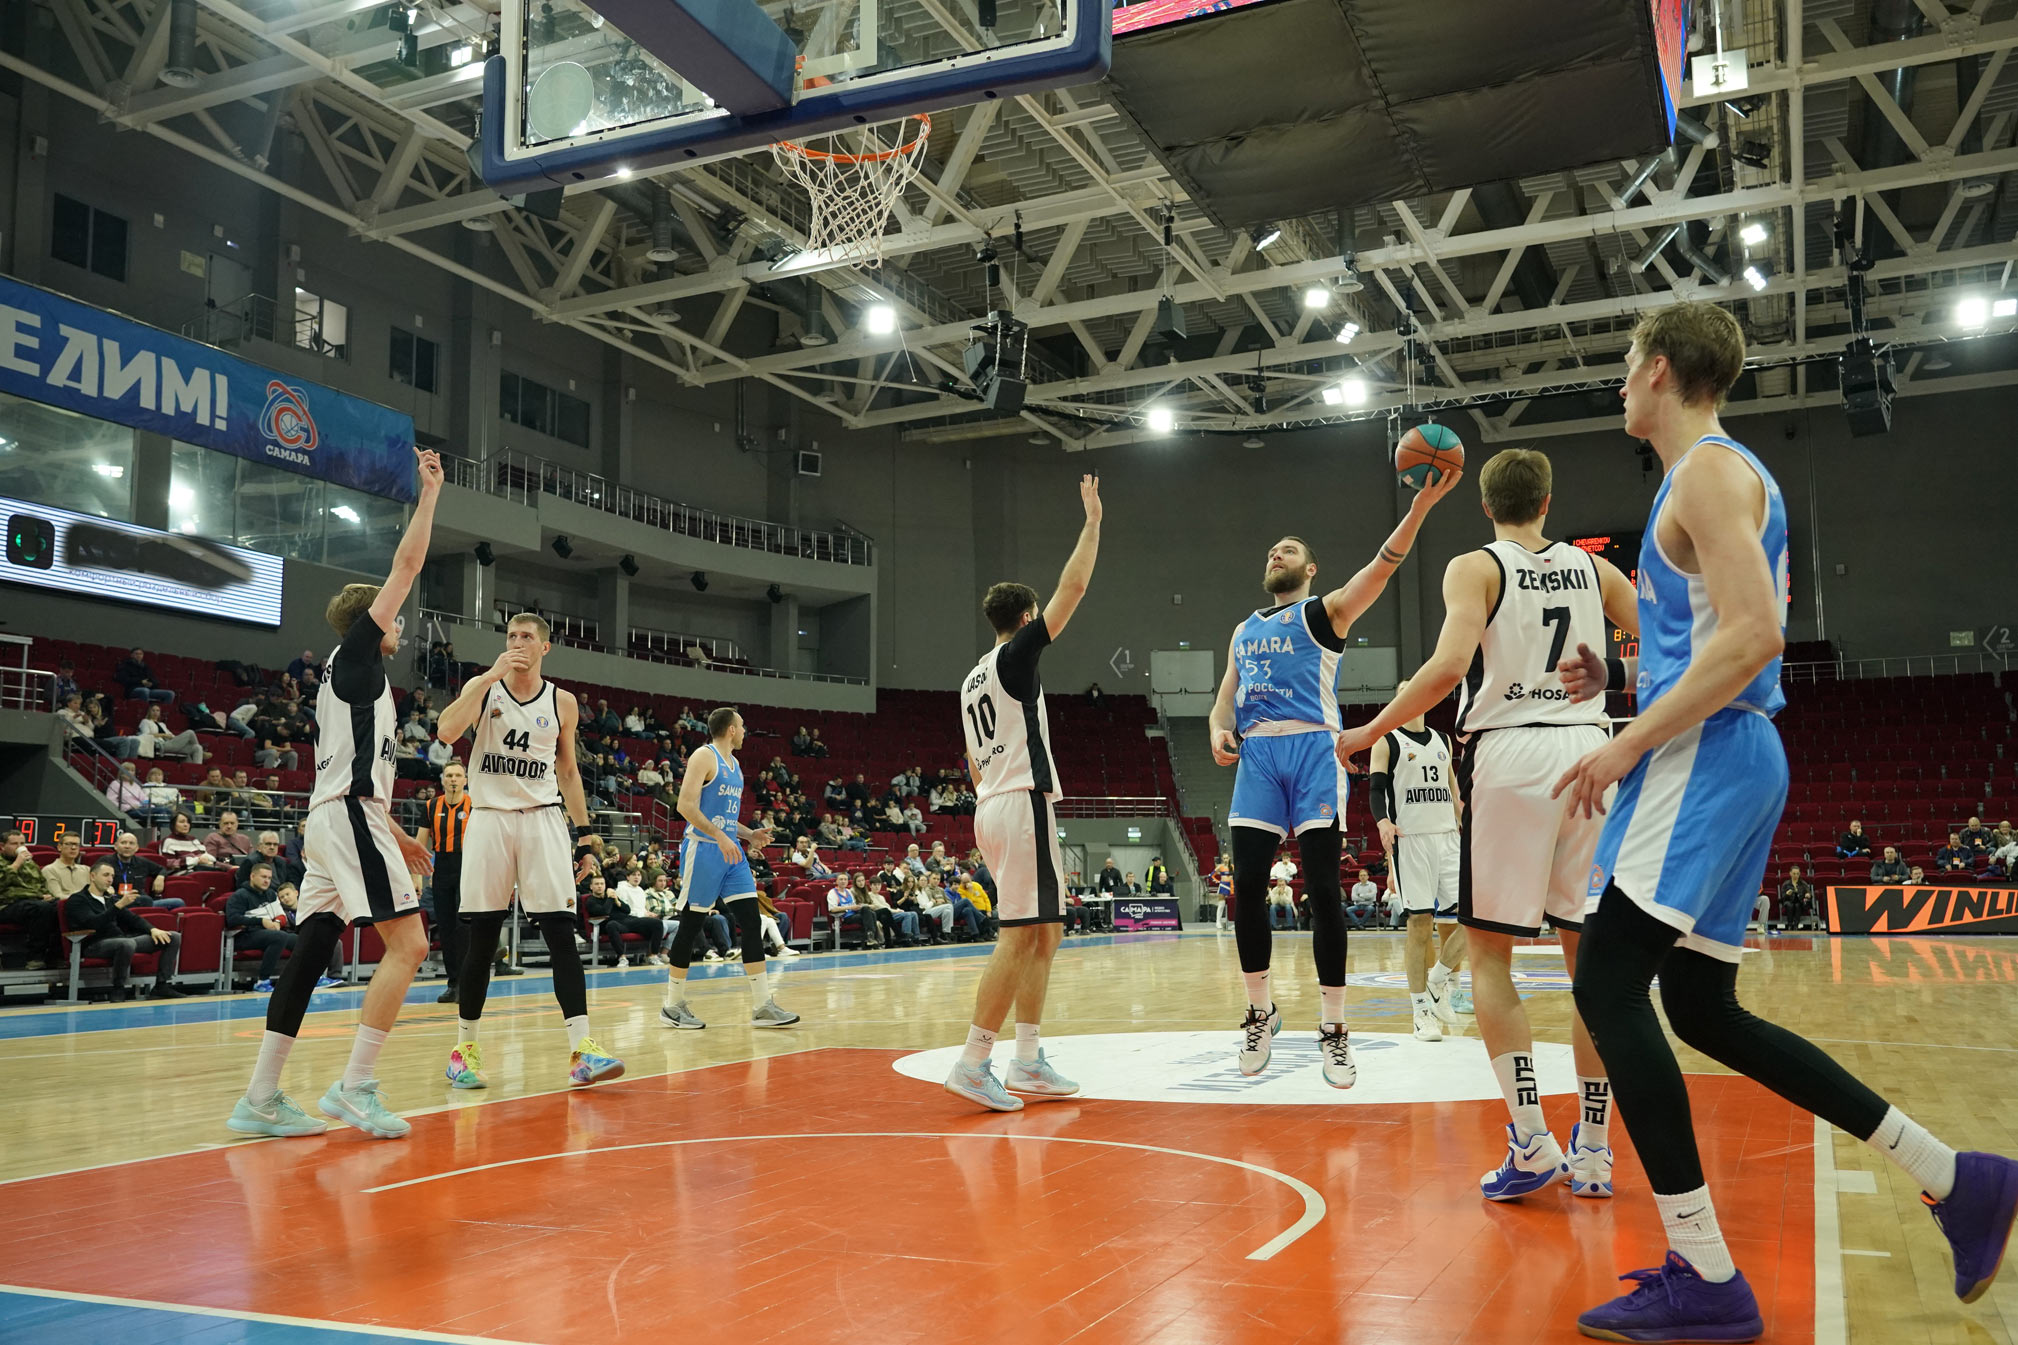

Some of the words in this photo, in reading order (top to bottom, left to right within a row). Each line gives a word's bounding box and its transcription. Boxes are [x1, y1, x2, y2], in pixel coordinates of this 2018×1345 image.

[265, 444, 311, 466] САМАРА
[1542, 606, 1571, 673] 7
[2000, 628, 2010, 643] 2
[1125, 650, 1130, 663] 1
[1245, 660, 1271, 679] 53
[1248, 682, 1293, 698] РОССТИ
[967, 693, 996, 748] 10
[503, 729, 530, 752] 44
[480, 753, 548, 780] AVTODOR
[1422, 765, 1439, 782] 13
[1405, 787, 1453, 805] AVTODO
[726, 800, 738, 813] 16
[1120, 905, 1152, 914] САМАРА
[1834, 888, 2018, 933] WINLI
[1584, 1081, 1609, 1125] ELITE
